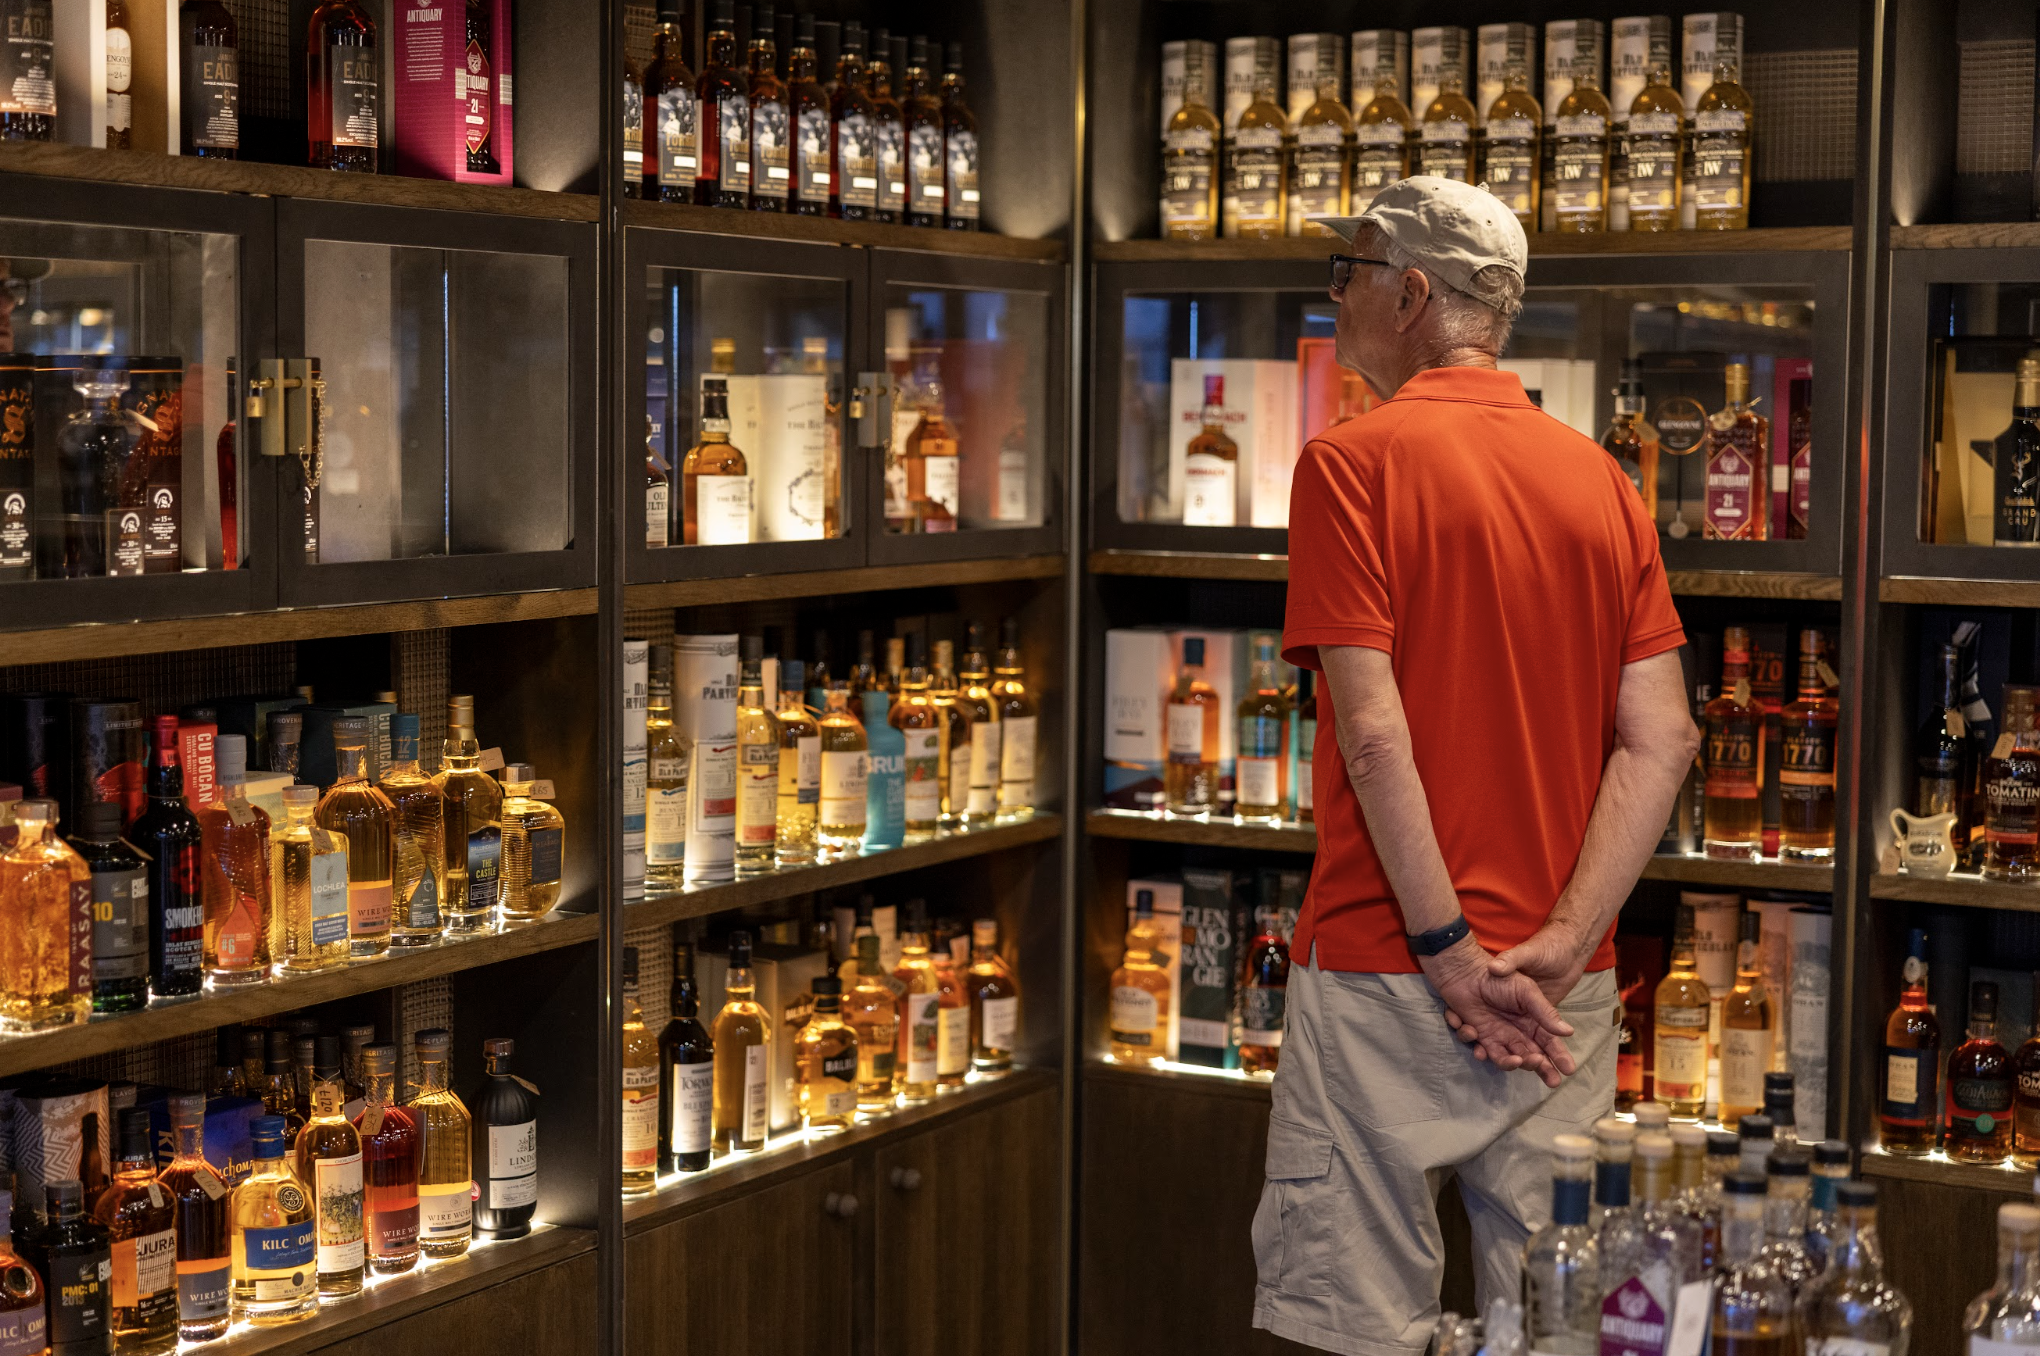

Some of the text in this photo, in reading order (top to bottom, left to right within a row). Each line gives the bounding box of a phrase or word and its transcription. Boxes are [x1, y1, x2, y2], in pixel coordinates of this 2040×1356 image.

[407, 8, 442, 22] ANTIQUARY
[471, 98, 479, 113] 21
[1708, 473, 1750, 488] ANTIQUARY
[1986, 783, 2040, 799] TOMATIN
[482, 858, 493, 869] THE
[475, 866, 497, 879] CASTLE
[313, 881, 346, 894] LOCHLEA
[93, 901, 113, 921] 10
[357, 907, 381, 917] WIRE
[78, 886, 90, 988] RAASAY
[221, 938, 236, 955] #6
[122, 1154, 144, 1162] JURA
[428, 1213, 452, 1222] WIRE
[382, 1228, 406, 1238] WIRE
[138, 1236, 176, 1256] JURA
[61, 1282, 99, 1297] PMC: 01
[189, 1292, 216, 1302] WIRE
